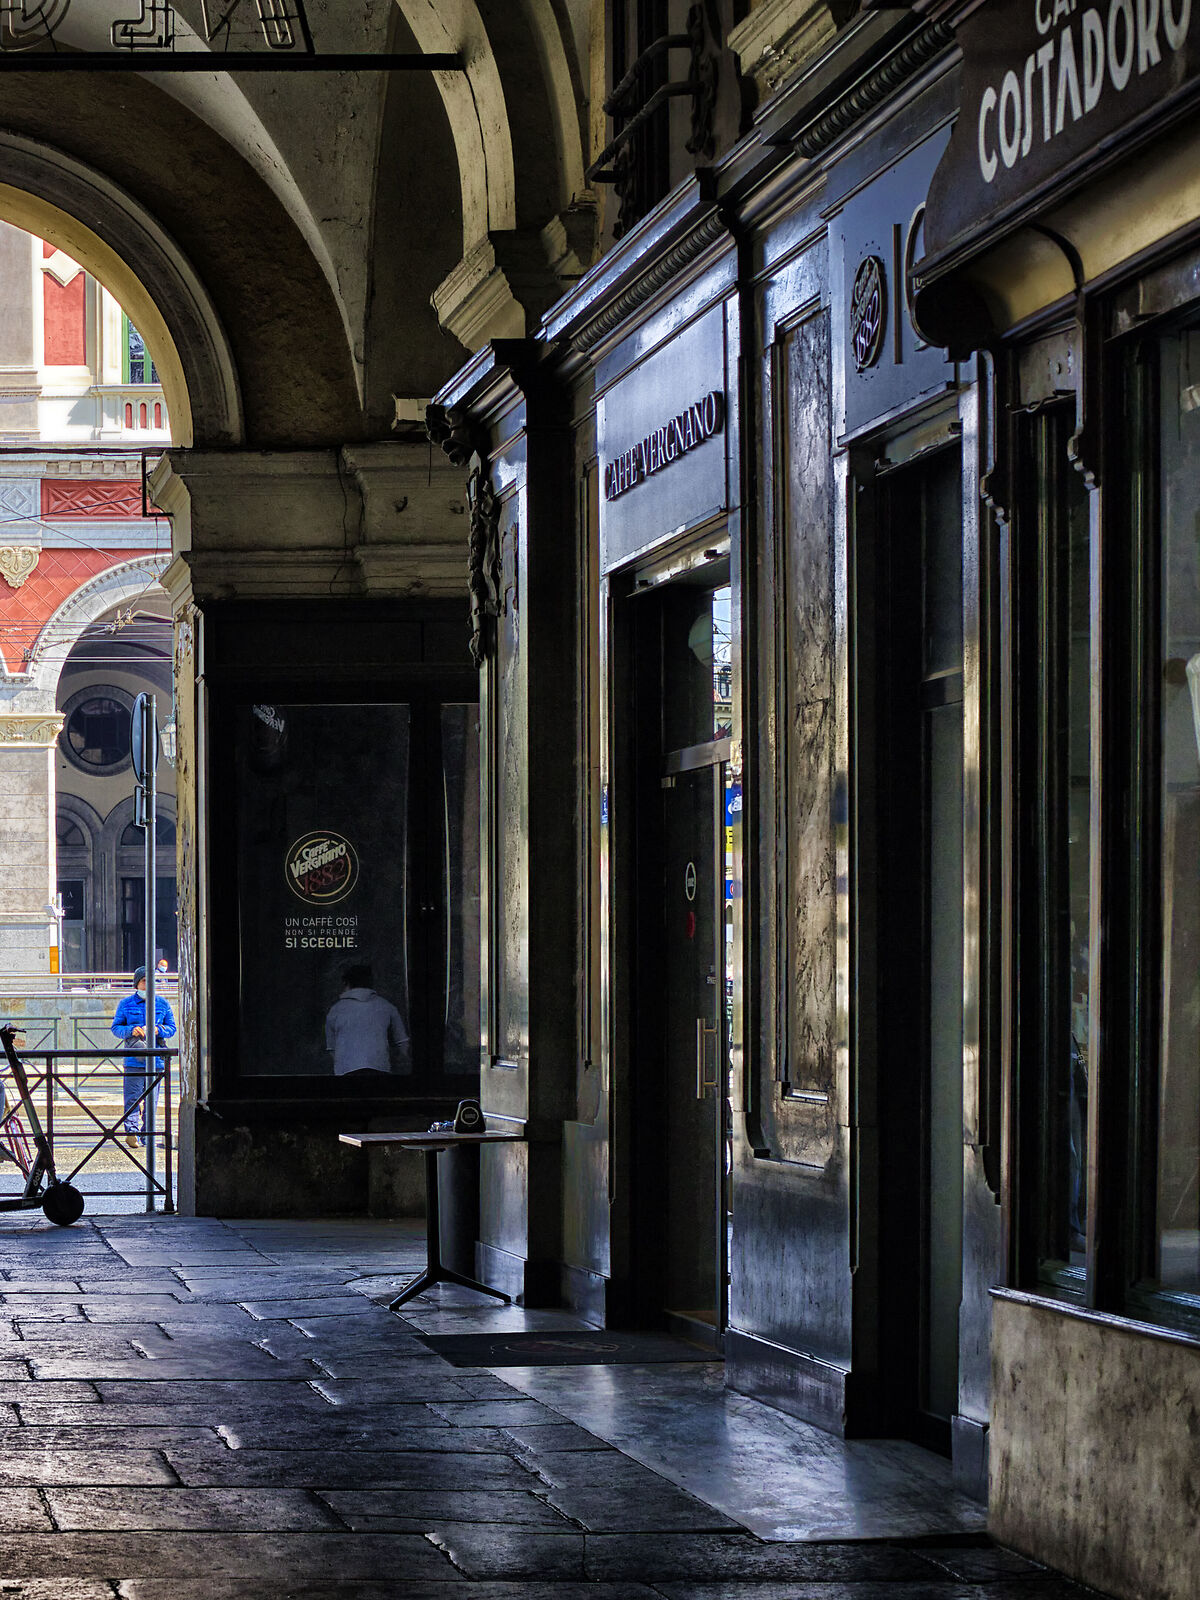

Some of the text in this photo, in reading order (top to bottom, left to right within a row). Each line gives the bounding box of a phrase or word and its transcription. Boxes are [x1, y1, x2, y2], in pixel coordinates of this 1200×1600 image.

[641, 391, 721, 477] VERGNANO
[302, 858, 346, 895] 1882
[285, 915, 358, 927] UN CAFFÈ COSÌ
[285, 938, 358, 948] SI SCEGLIE.
